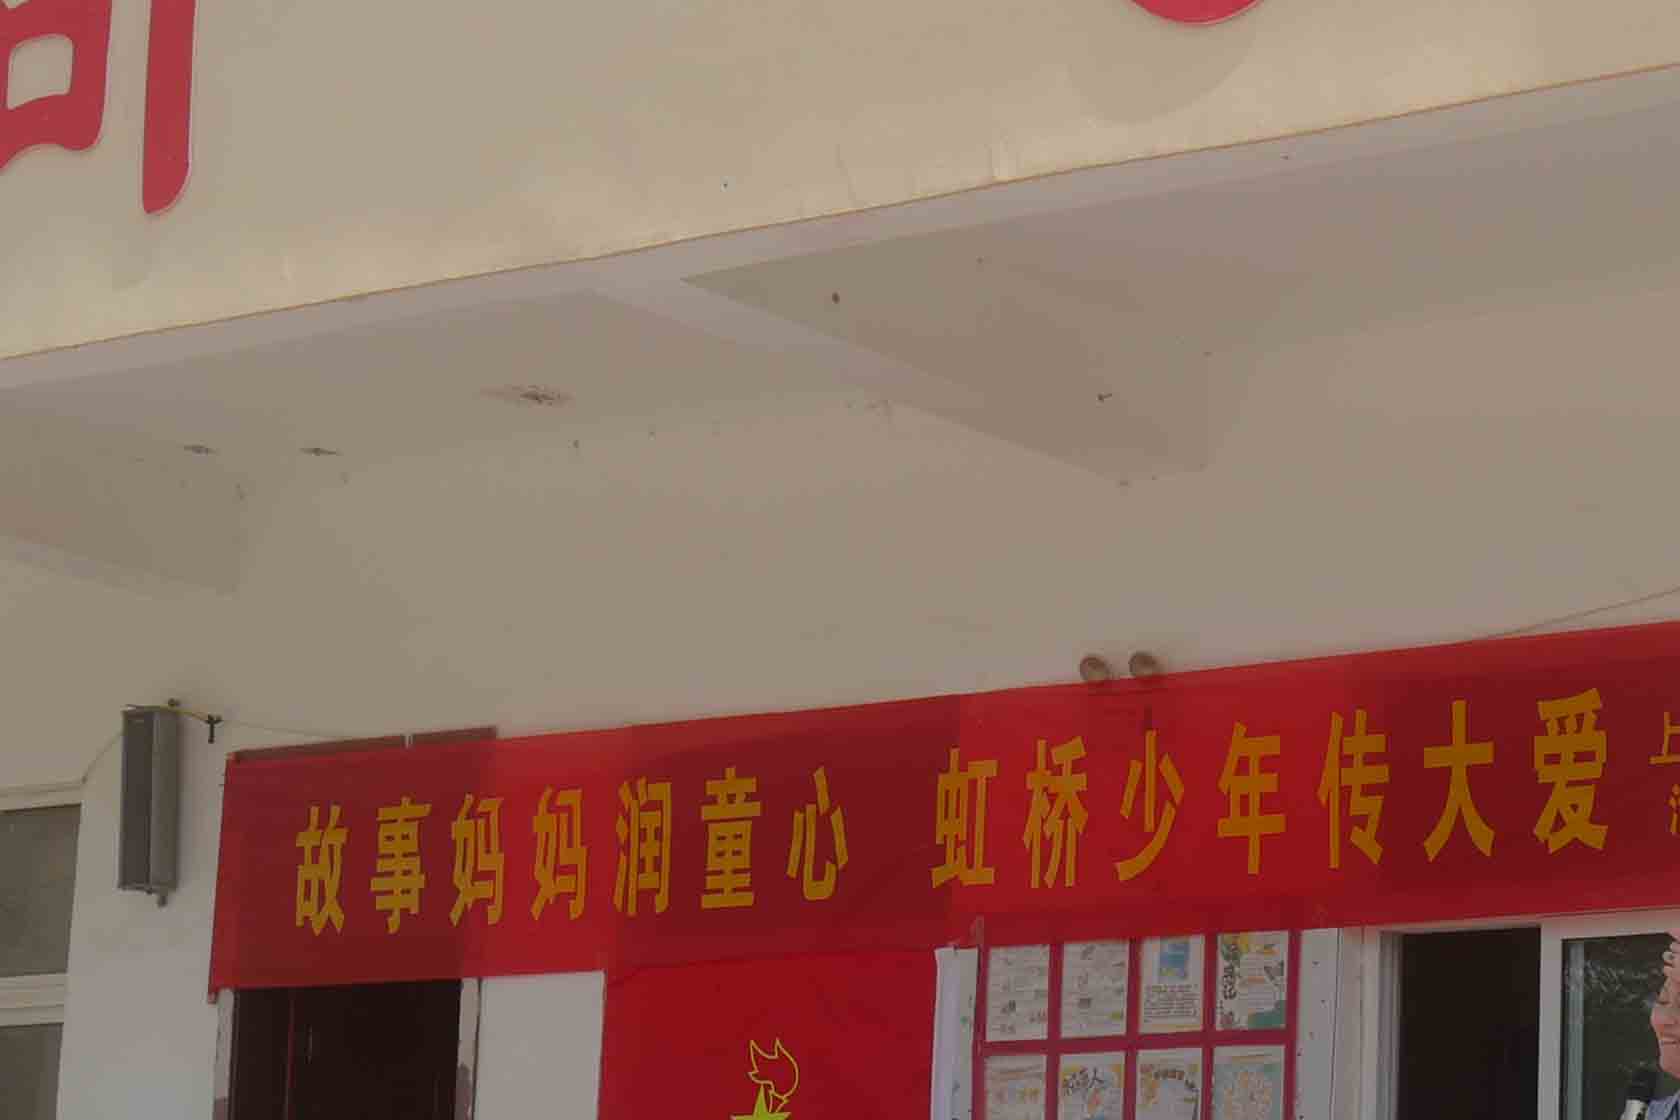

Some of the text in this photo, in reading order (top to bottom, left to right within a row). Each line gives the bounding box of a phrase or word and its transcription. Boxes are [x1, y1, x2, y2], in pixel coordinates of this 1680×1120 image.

[294, 687, 1609, 936] 故事妈妈润童心 虹桥少年传大爱
